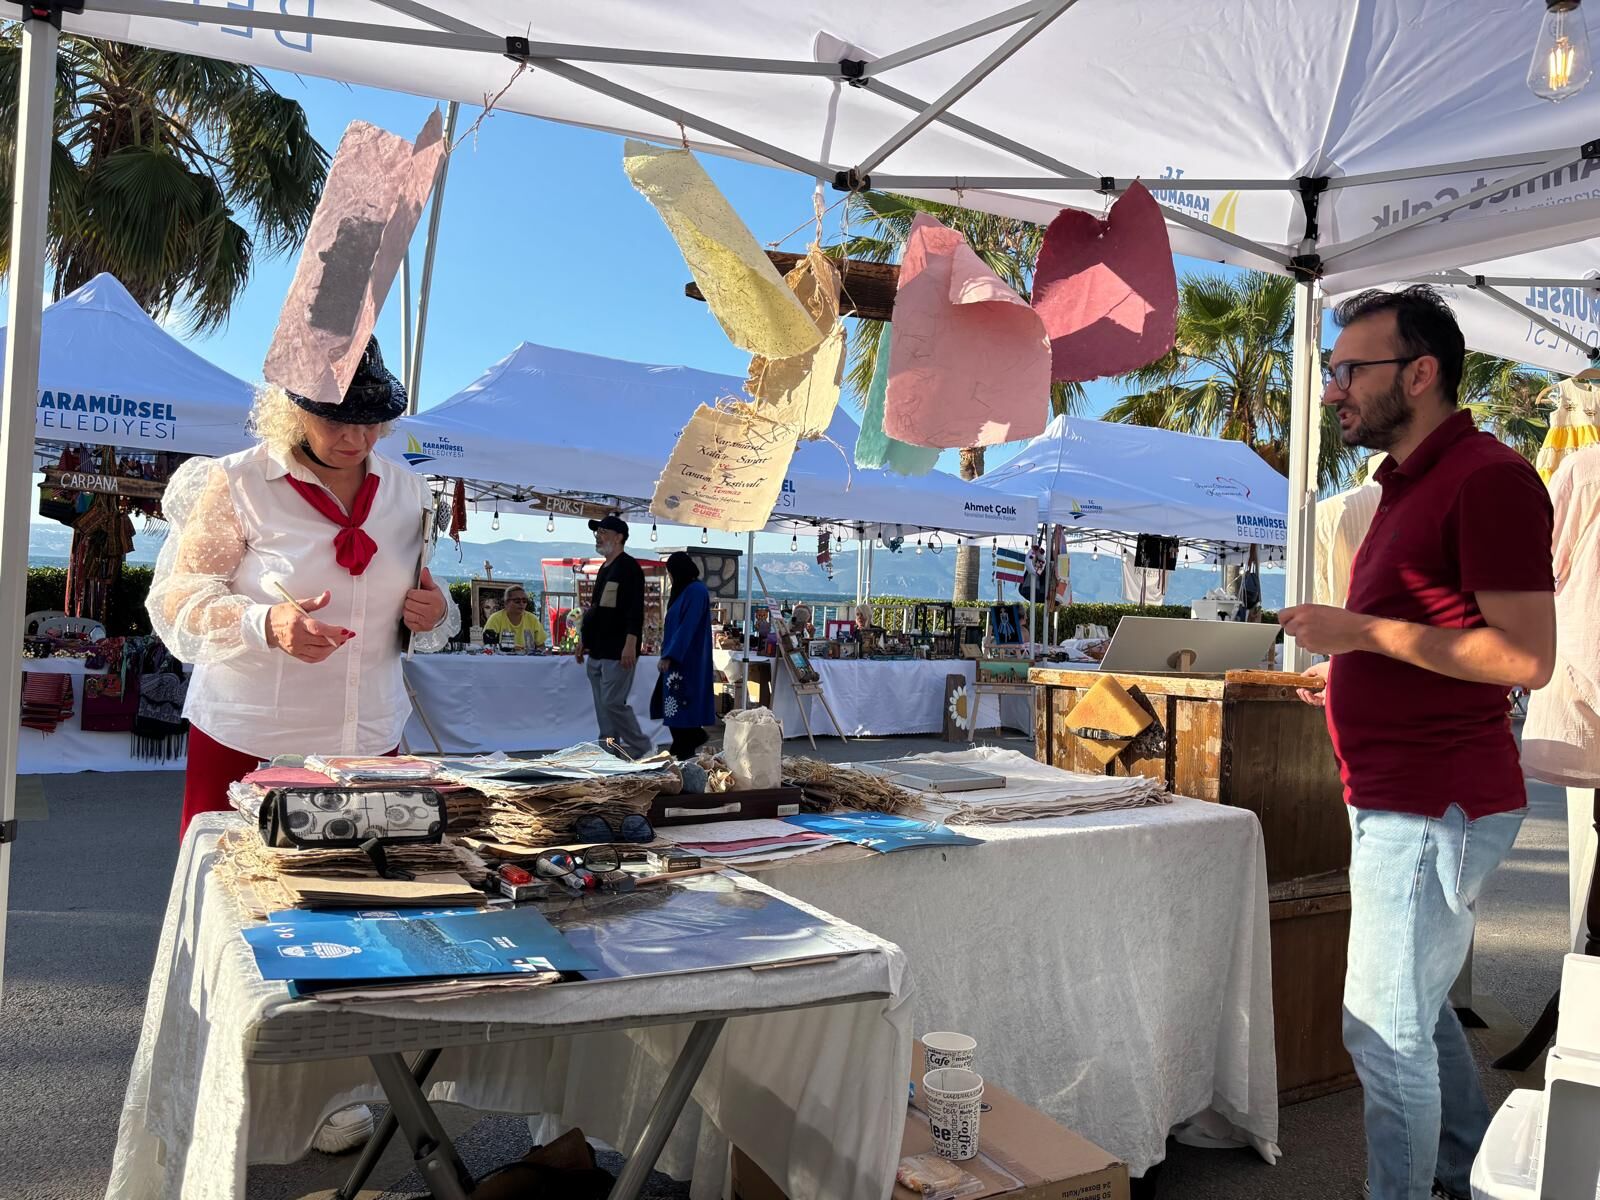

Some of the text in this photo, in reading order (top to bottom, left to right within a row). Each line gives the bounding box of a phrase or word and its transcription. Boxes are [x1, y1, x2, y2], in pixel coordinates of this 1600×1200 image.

[36, 410, 176, 441] ELEDİYESİ
[422, 441, 464, 453] KARAMÜRSEL
[60, 472, 119, 492] ÇARPANA
[701, 484, 708, 492] 4
[964, 501, 994, 513] Ahmet
[995, 504, 1017, 517] Çalık
[1236, 514, 1287, 530] KARAMÜRSEL
[951, 1114, 959, 1160] cappuccino
[958, 1121, 972, 1157] coffee
